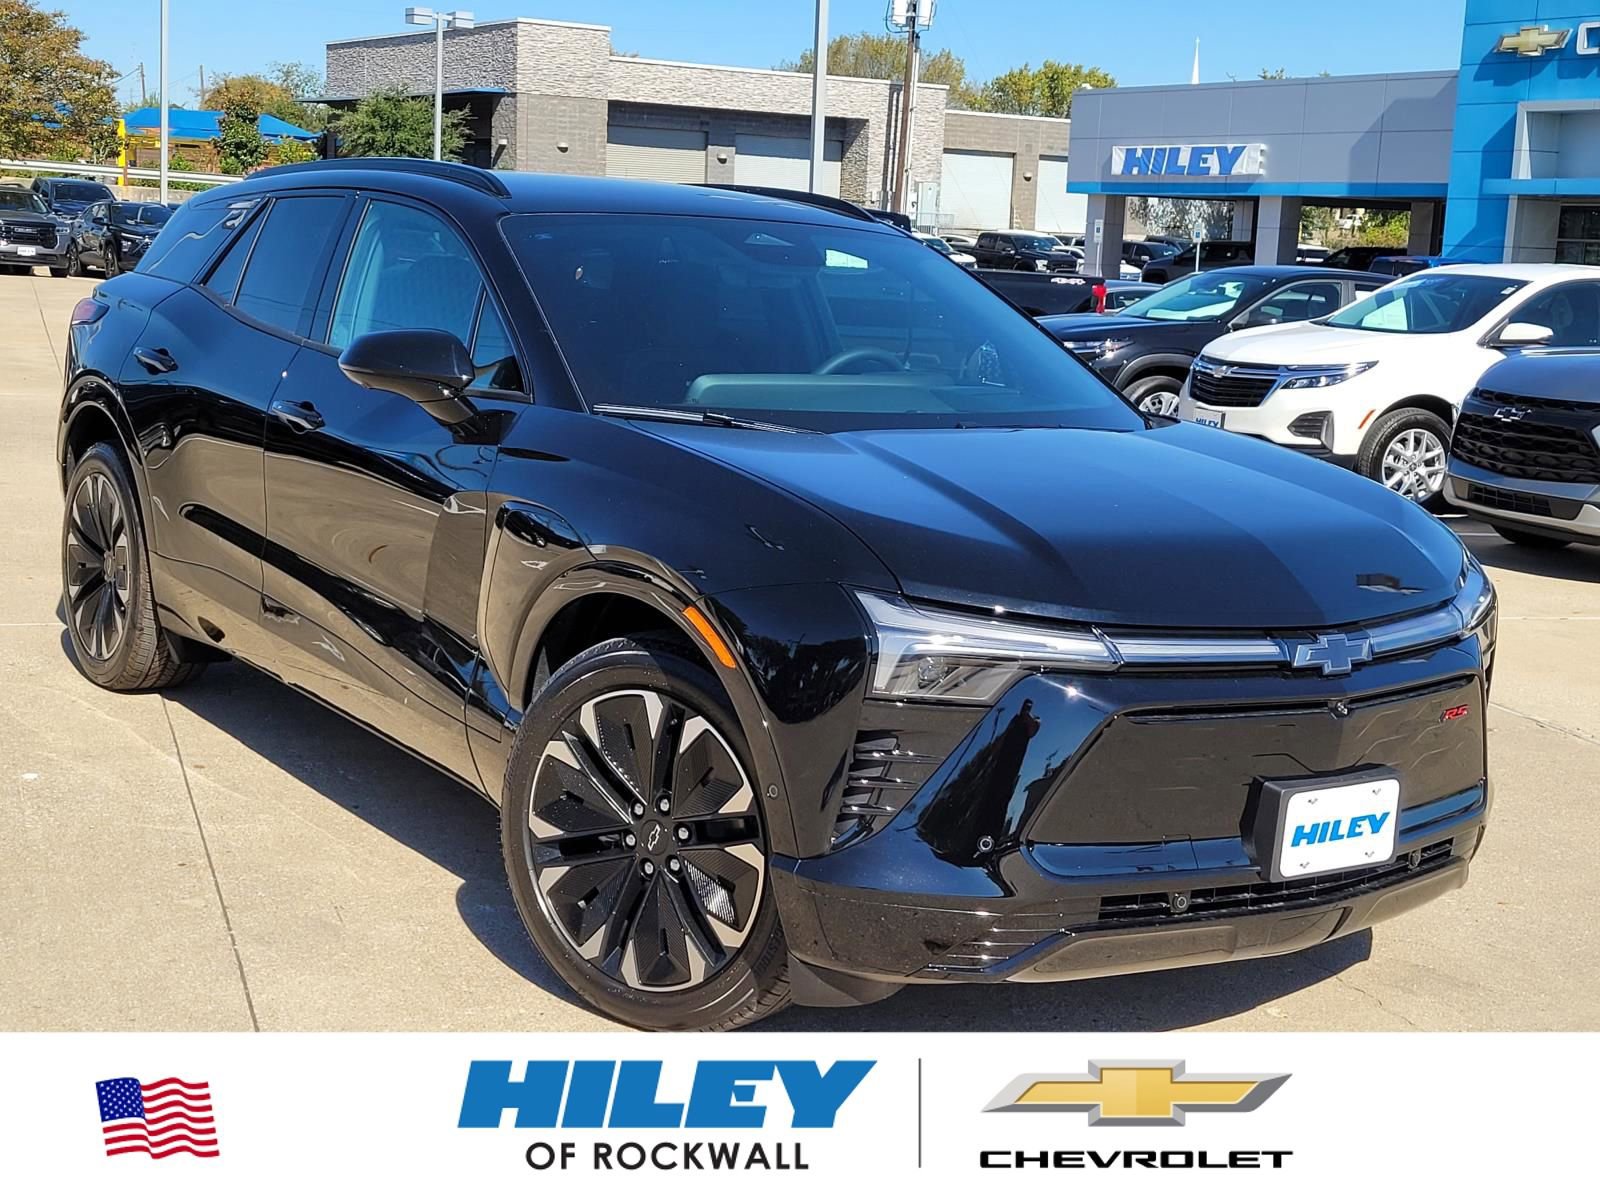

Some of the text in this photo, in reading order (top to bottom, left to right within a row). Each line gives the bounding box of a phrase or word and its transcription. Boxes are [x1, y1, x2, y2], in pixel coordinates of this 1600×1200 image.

[1121, 145, 1248, 176] HILEY
[1442, 704, 1469, 721] RS
[1290, 811, 1391, 848] HILEY
